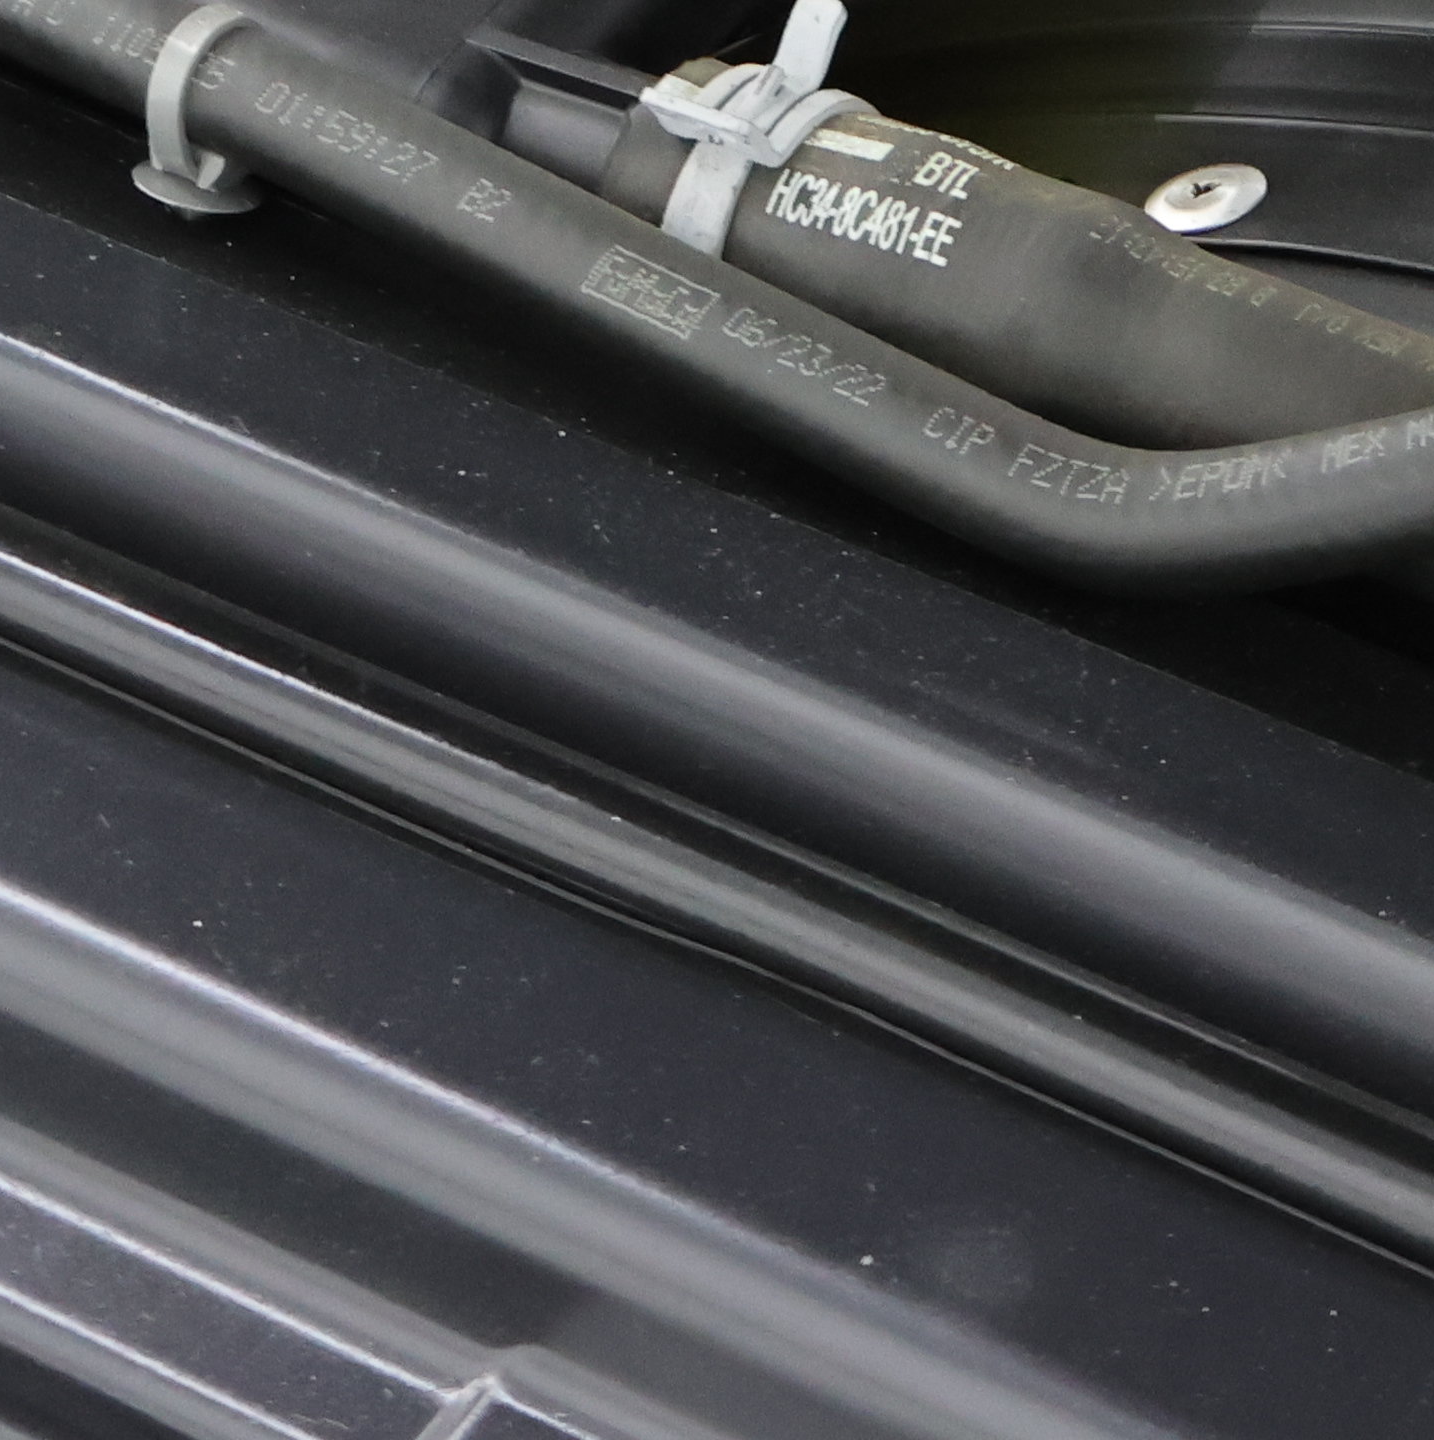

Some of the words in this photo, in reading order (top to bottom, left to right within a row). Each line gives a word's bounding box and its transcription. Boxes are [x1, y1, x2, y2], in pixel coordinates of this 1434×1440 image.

[251, 71, 440, 195] 01:59:27
[911, 145, 982, 202] BTL
[762, 162, 965, 270] HC34-8C481-EE
[719, 296, 889, 414] 06/23/22
[1314, 425, 1393, 474] MEX
